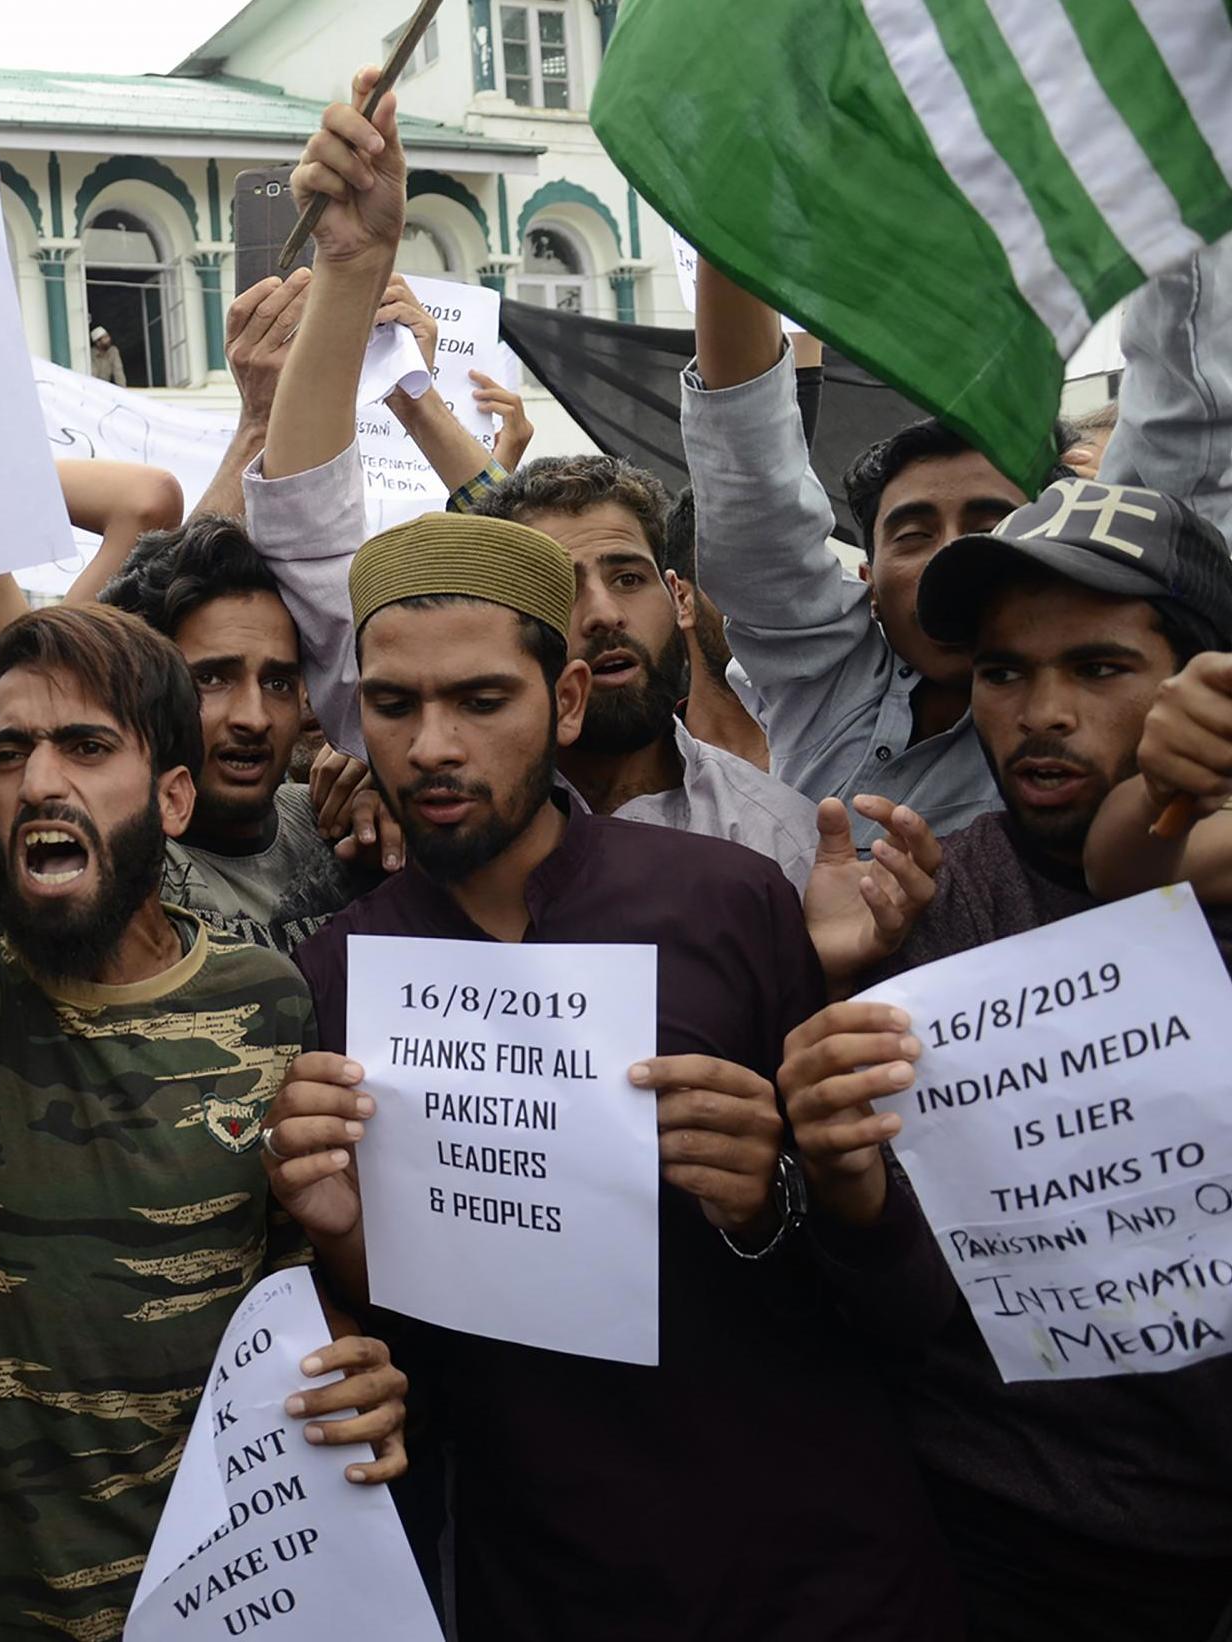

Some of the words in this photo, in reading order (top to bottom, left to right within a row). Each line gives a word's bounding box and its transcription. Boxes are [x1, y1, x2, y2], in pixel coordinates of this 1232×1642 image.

[438, 338, 474, 356] EDIA
[400, 982, 588, 1021] 16/8/2019
[928, 962, 1122, 1049] 16/8/2019
[389, 1036, 486, 1073] THANKS
[496, 1043, 544, 1076] FOR
[552, 1049, 598, 1080] ALL
[916, 1056, 1049, 1114] INDIAN
[1060, 1014, 1192, 1078] MEDIA
[425, 1091, 557, 1131] PAKISTANI
[1014, 1119, 1046, 1150] IS
[1056, 1096, 1136, 1139] LIER
[437, 1140, 547, 1179] LEADERS
[990, 1157, 1143, 1213] THANKS
[1150, 1141, 1206, 1175] TO
[429, 1187, 445, 1214] &
[452, 1191, 562, 1233] PEOPLES
[1105, 1205, 1177, 1244] AND
[234, 1328, 272, 1369] GO
[226, 1428, 287, 1485] ANT
[173, 1547, 269, 1619] WAKE
[271, 1528, 319, 1562] UP
[222, 1588, 296, 1636] UNO
